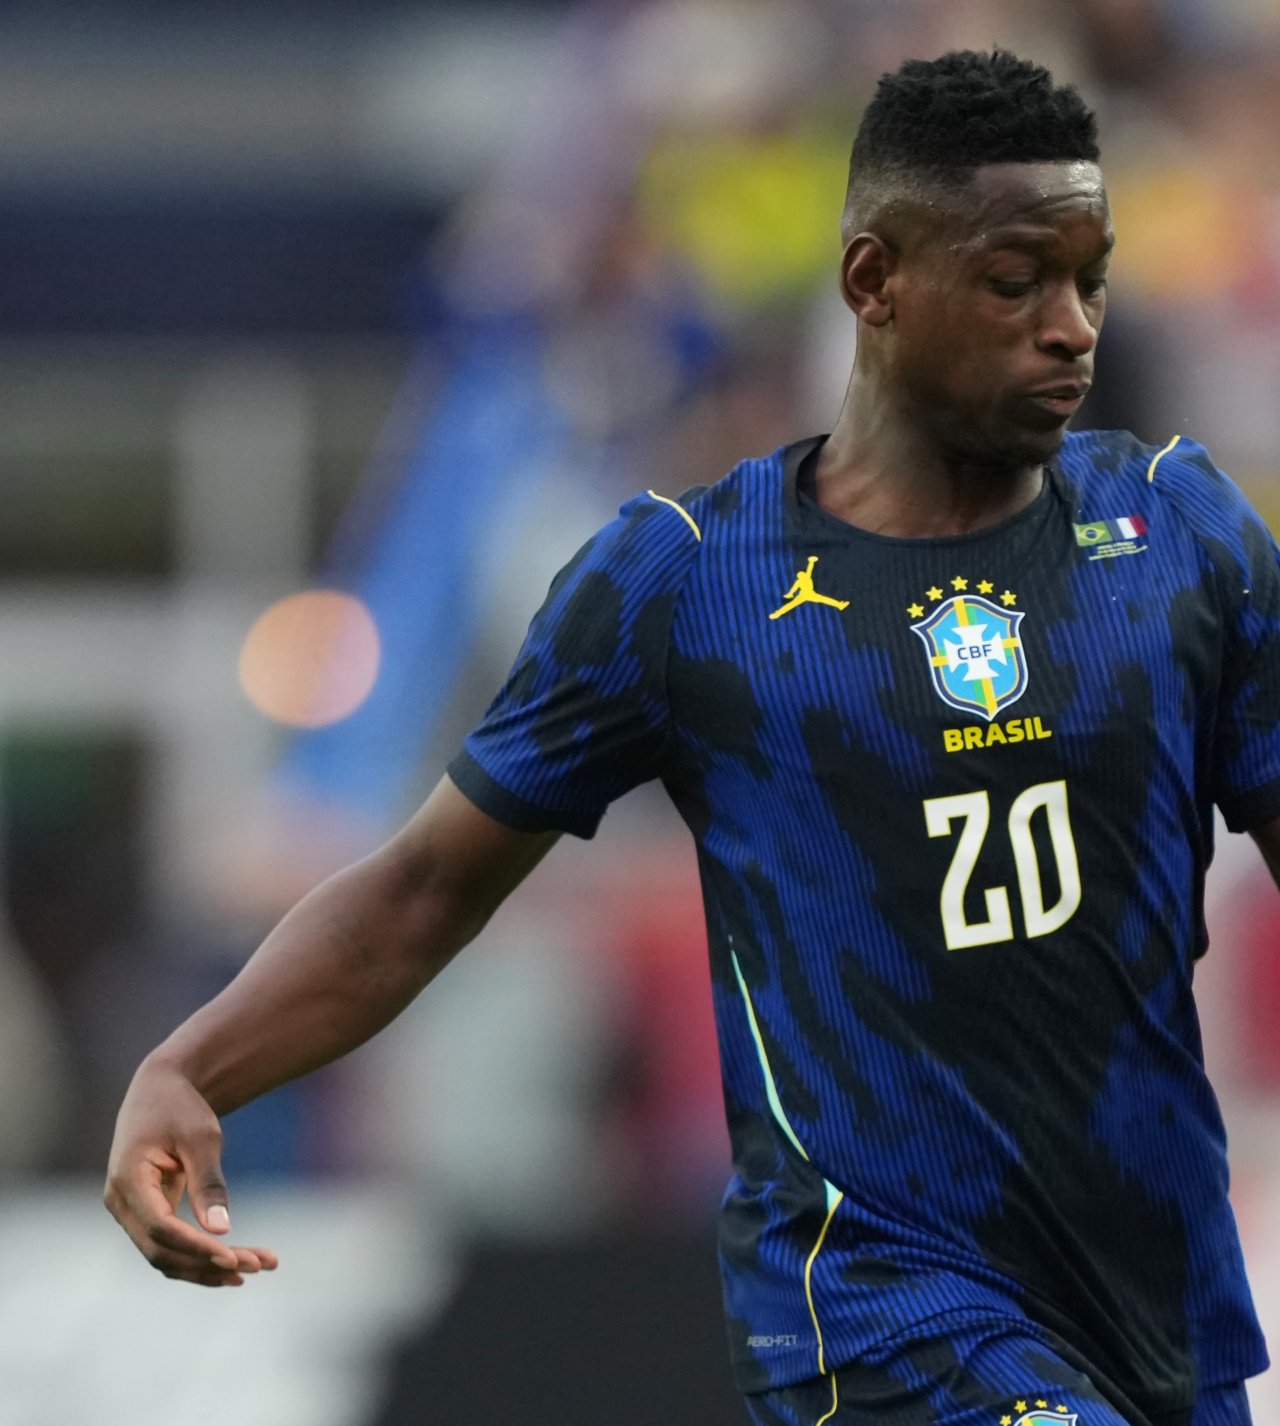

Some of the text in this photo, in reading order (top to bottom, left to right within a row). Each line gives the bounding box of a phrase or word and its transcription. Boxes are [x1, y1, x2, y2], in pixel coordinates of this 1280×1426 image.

[957, 643, 993, 660] CBF
[943, 716, 1053, 753] BRASIL
[923, 779, 1082, 951] 20
